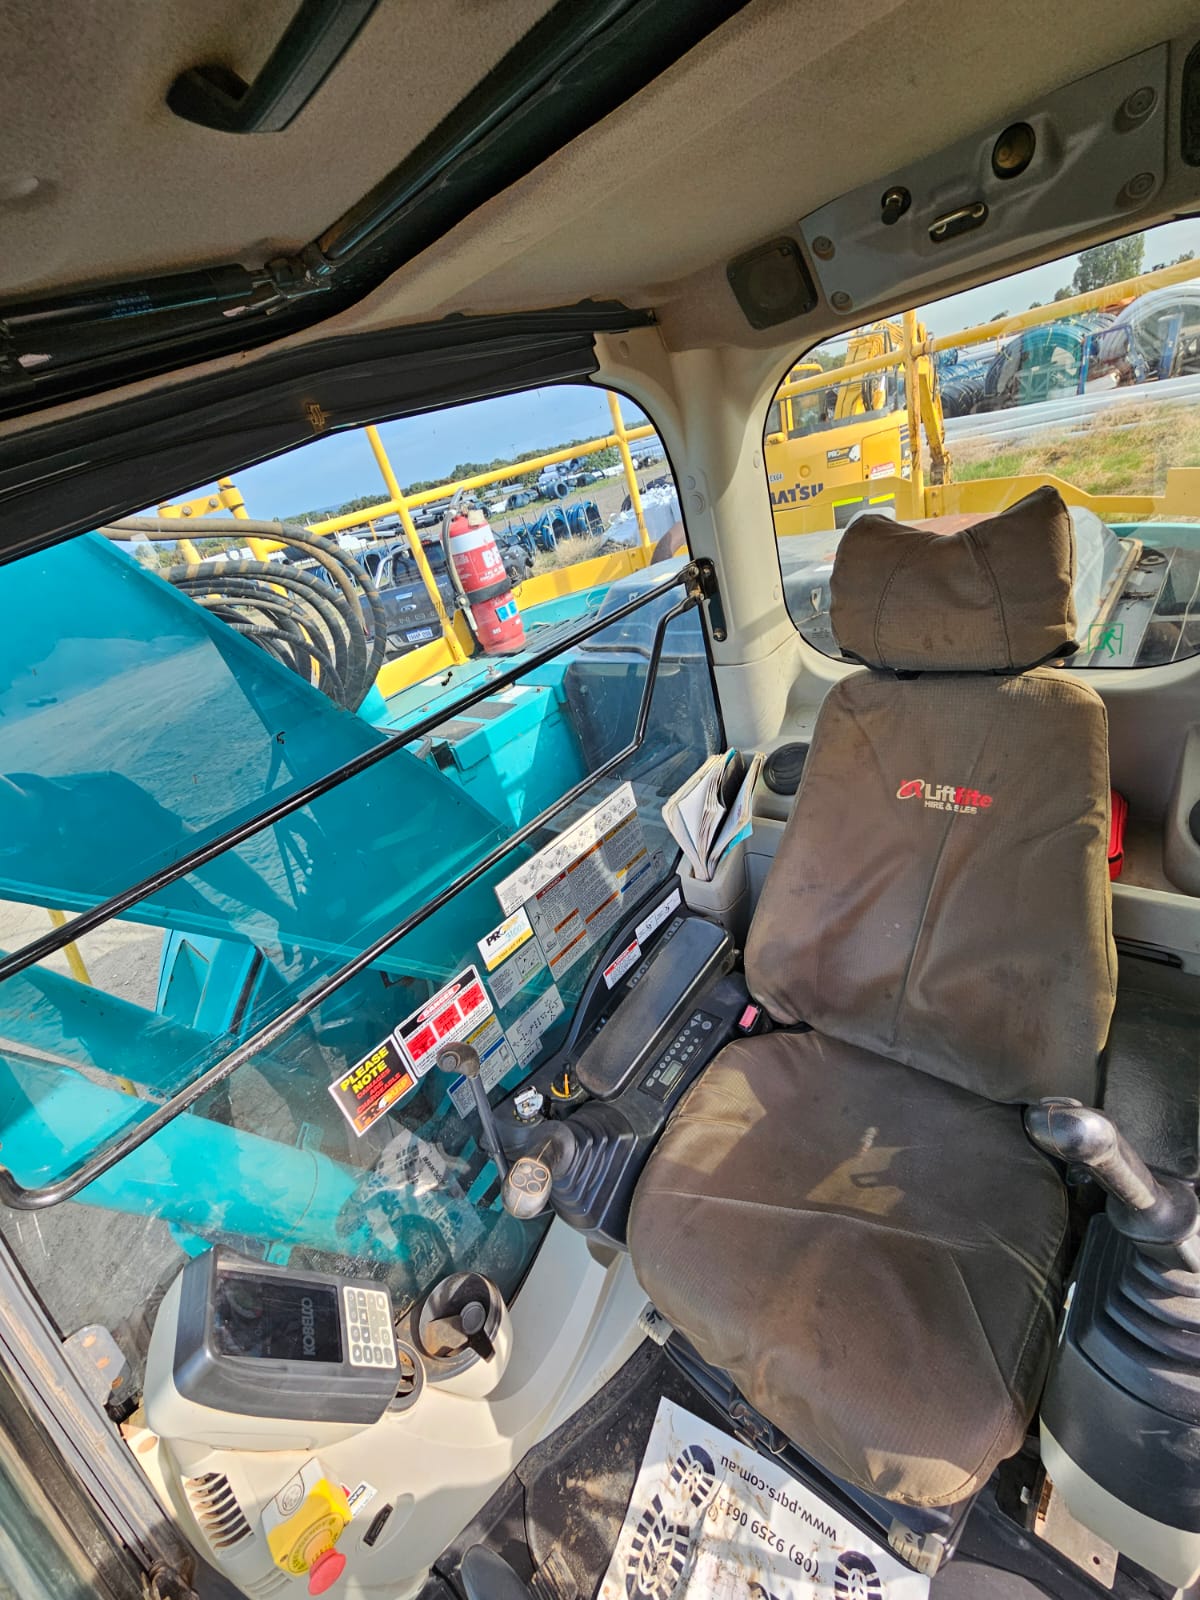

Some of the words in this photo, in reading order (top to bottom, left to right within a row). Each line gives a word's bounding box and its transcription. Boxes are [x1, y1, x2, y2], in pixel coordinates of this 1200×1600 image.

[924, 800, 944, 810] HIRE
[945, 803, 953, 811] &
[422, 988, 453, 1017] DANGER
[339, 1045, 389, 1091] PLEASE
[351, 1059, 387, 1093] NOTE
[355, 1067, 391, 1099] DAMAGES
[355, 1072, 400, 1114] CHARGEABLE
[368, 1080, 384, 1095] ARE
[300, 1296, 316, 1356] KOBELCO
[718, 1496, 747, 1527] 0611
[720, 1454, 837, 1542] www.pqrs.com.au
[750, 1519, 785, 1552] 9259
[789, 1544, 820, 1578] (08)
